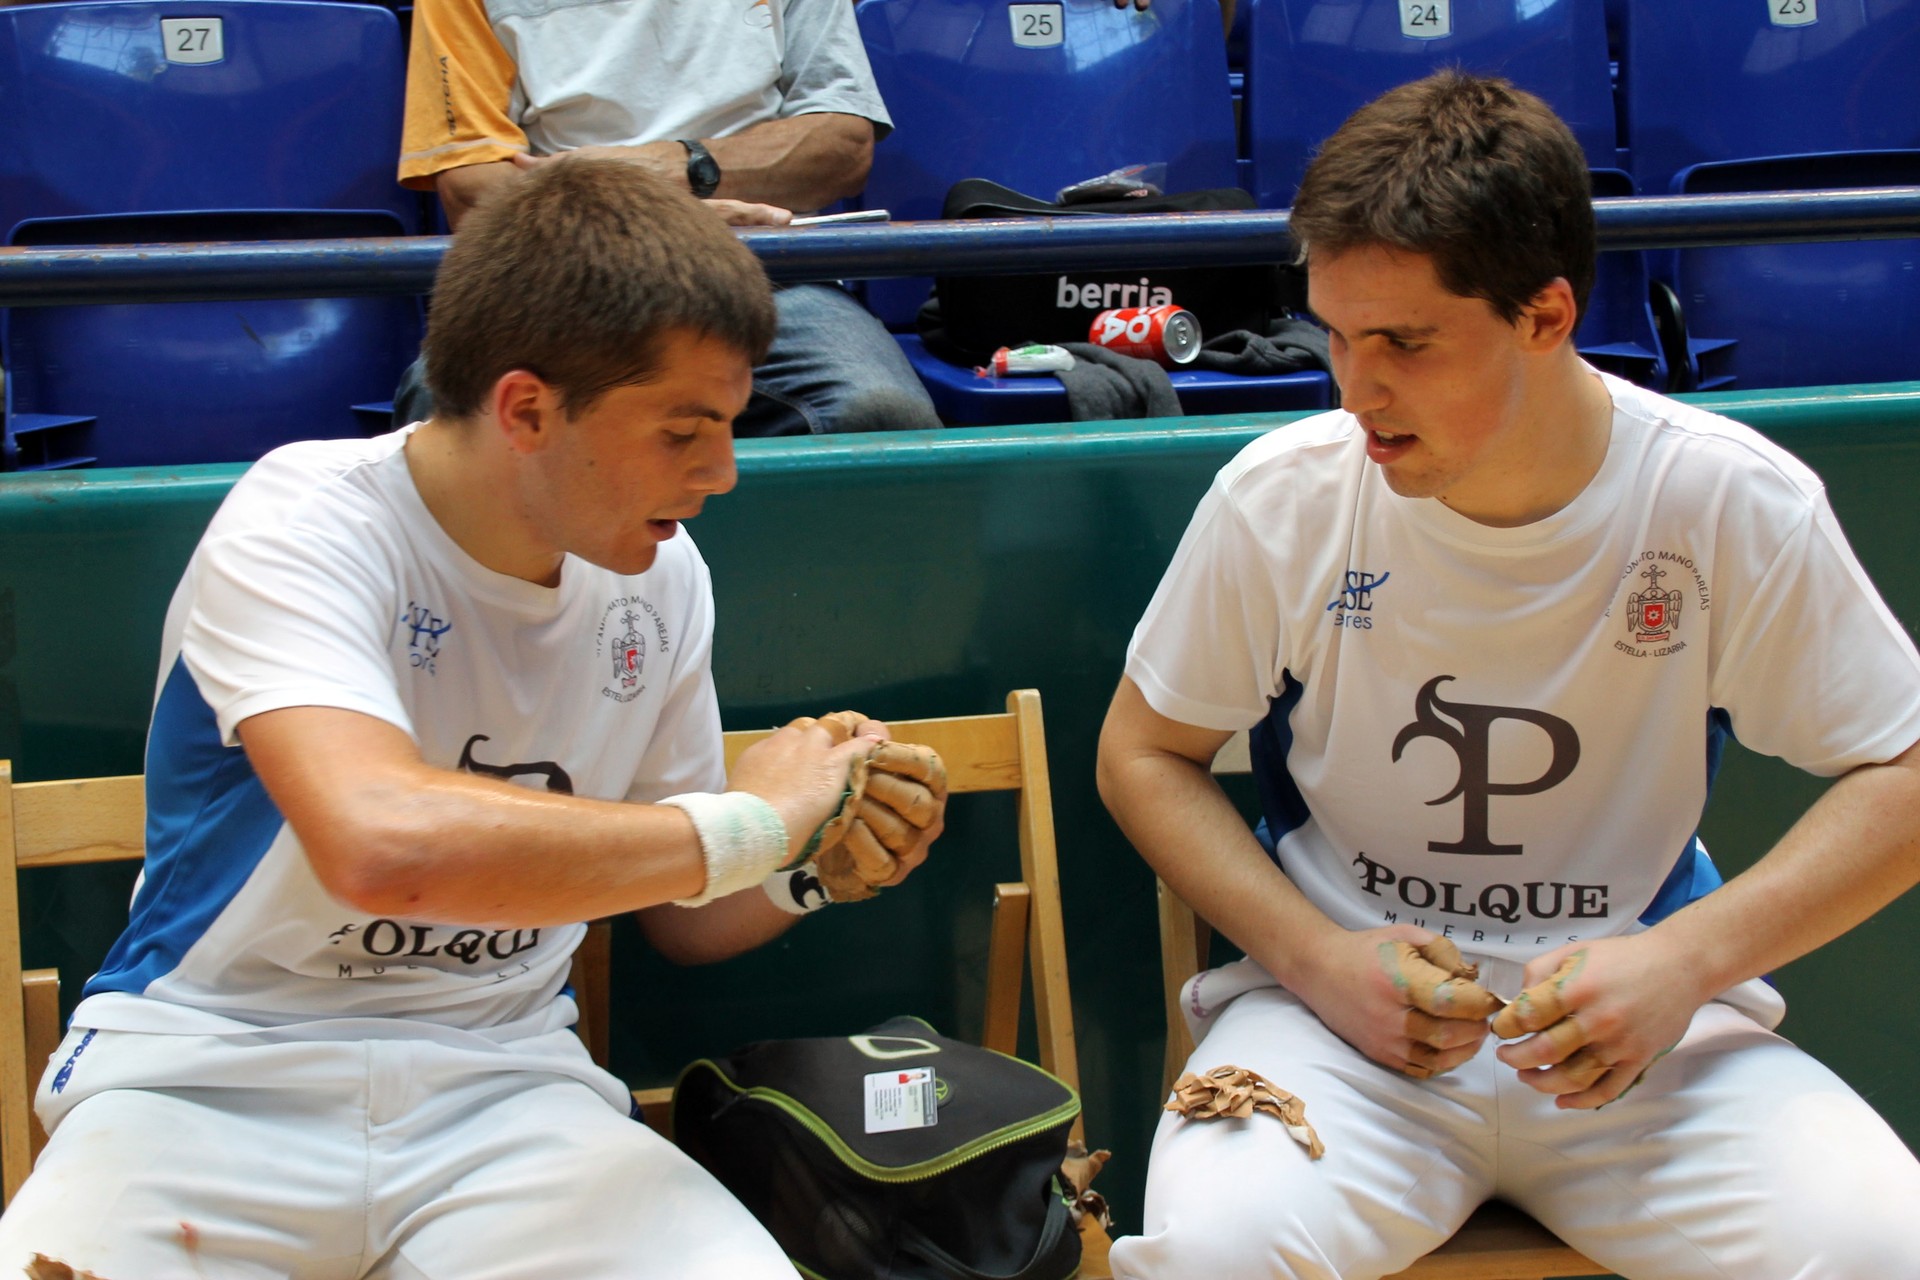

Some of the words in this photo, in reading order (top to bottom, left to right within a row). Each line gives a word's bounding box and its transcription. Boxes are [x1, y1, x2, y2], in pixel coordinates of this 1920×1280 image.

[1410, 4, 1439, 26] 24
[1779, 0, 1806, 14] 23
[1022, 14, 1053, 36] 25
[177, 28, 211, 51] 27
[1056, 275, 1173, 309] berria
[1658, 551, 1694, 569] MANO
[1691, 567, 1711, 611] PAREJAS
[1614, 640, 1647, 657] ESTELLA
[1654, 641, 1687, 657] LIZARRA
[1352, 851, 1609, 924] POLQUE
